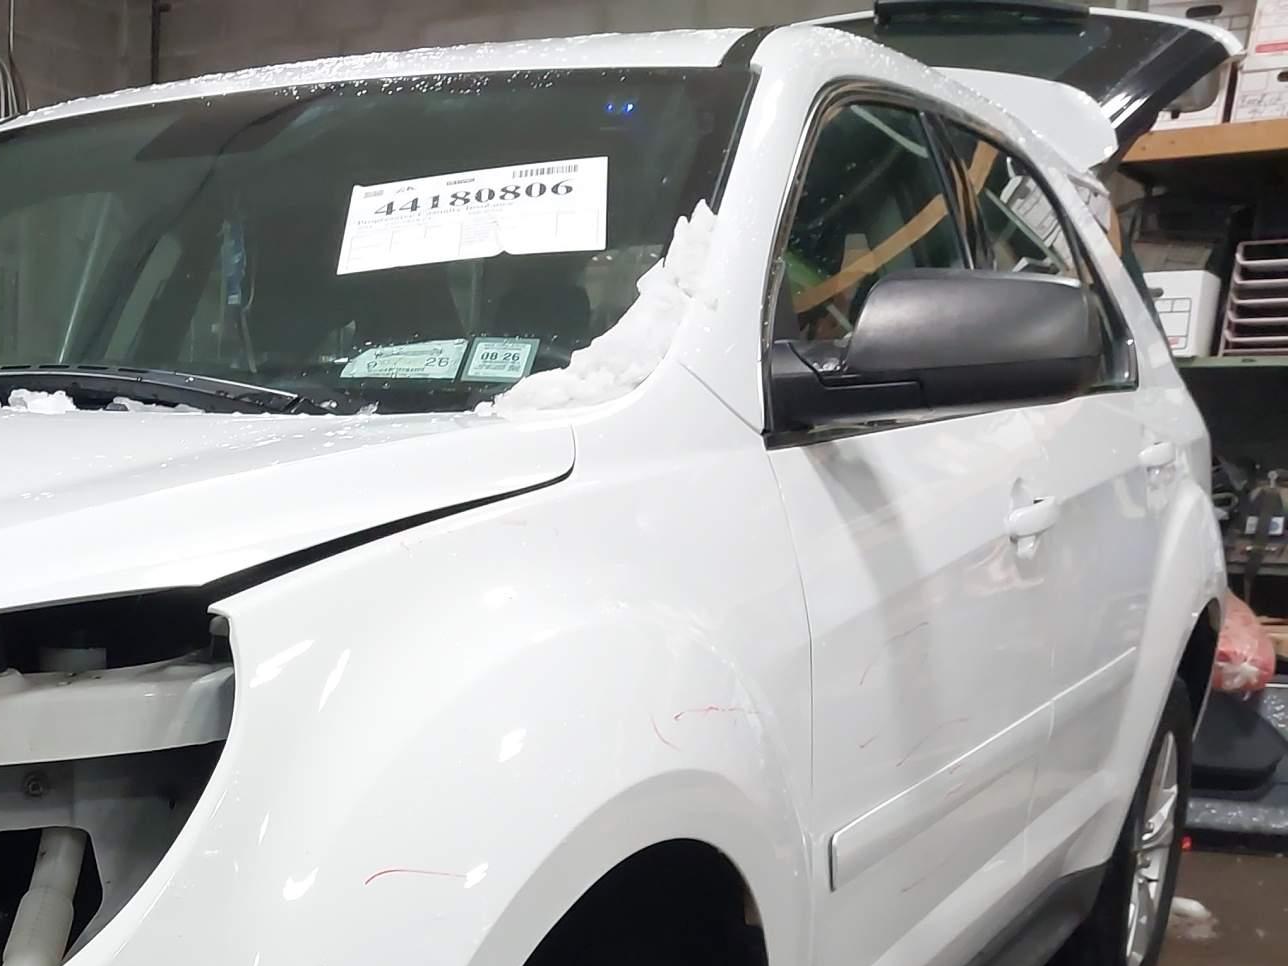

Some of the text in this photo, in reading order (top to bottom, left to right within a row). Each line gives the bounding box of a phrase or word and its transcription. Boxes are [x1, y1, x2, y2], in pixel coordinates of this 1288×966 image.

[373, 179, 575, 216] 44180806
[480, 352, 520, 361] 08 26
